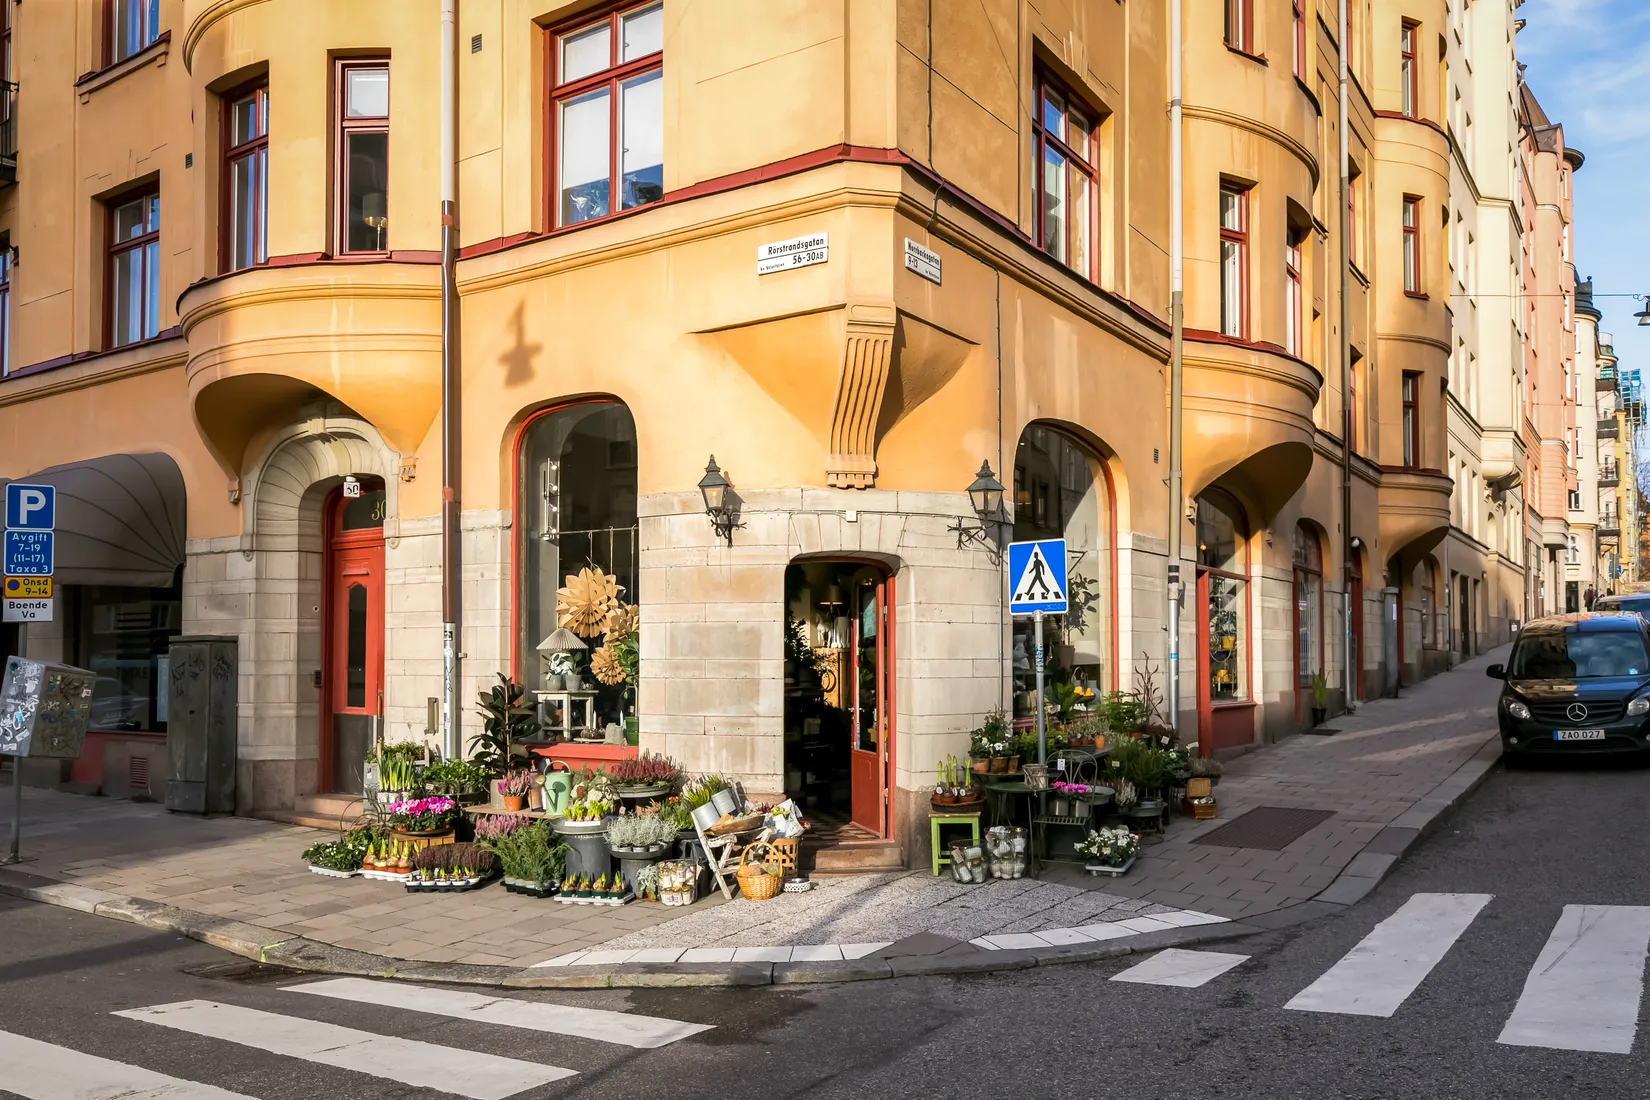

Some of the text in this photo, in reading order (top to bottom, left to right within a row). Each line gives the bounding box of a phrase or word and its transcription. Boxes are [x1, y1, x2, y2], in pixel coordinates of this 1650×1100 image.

[768, 238, 824, 255] Rörstrandsgatan
[20, 489, 46, 525] P
[12, 532, 47, 543] Avgift
[18, 543, 41, 552] 7-19
[13, 553, 45, 563] (11-17)
[9, 564, 49, 573] Taxa 3
[23, 578, 48, 586] Onsd
[25, 587, 48, 595] 9-14
[9, 601, 48, 609] Boende
[22, 610, 36, 618] Va
[1582, 730, 1601, 739] 027
